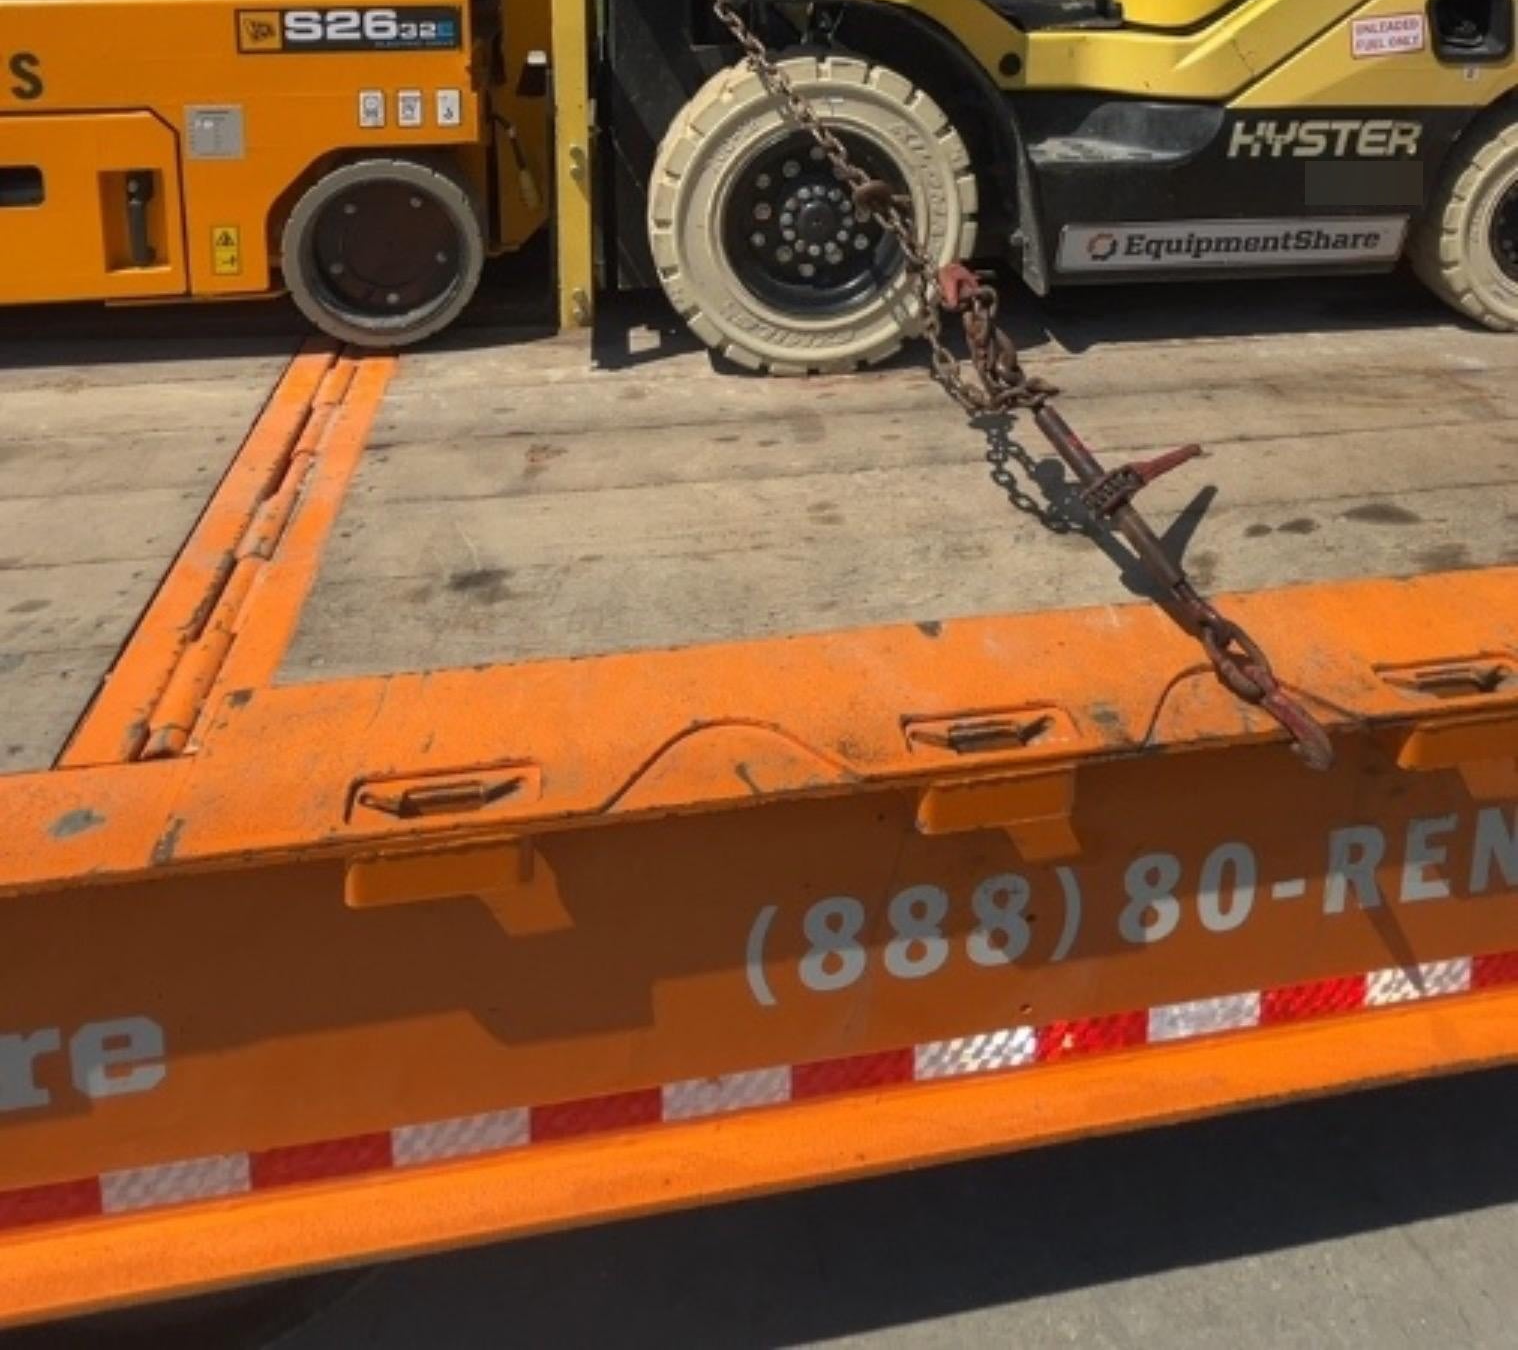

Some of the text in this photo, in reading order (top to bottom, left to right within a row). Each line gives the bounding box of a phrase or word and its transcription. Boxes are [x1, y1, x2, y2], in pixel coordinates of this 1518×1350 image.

[1356, 34, 1420, 52] FUEL ONLY
[1227, 119, 1423, 158] HYSTER
[1124, 229, 1381, 261] EquipmentShare
[745, 806, 1518, 1007] (888) 80-REN
